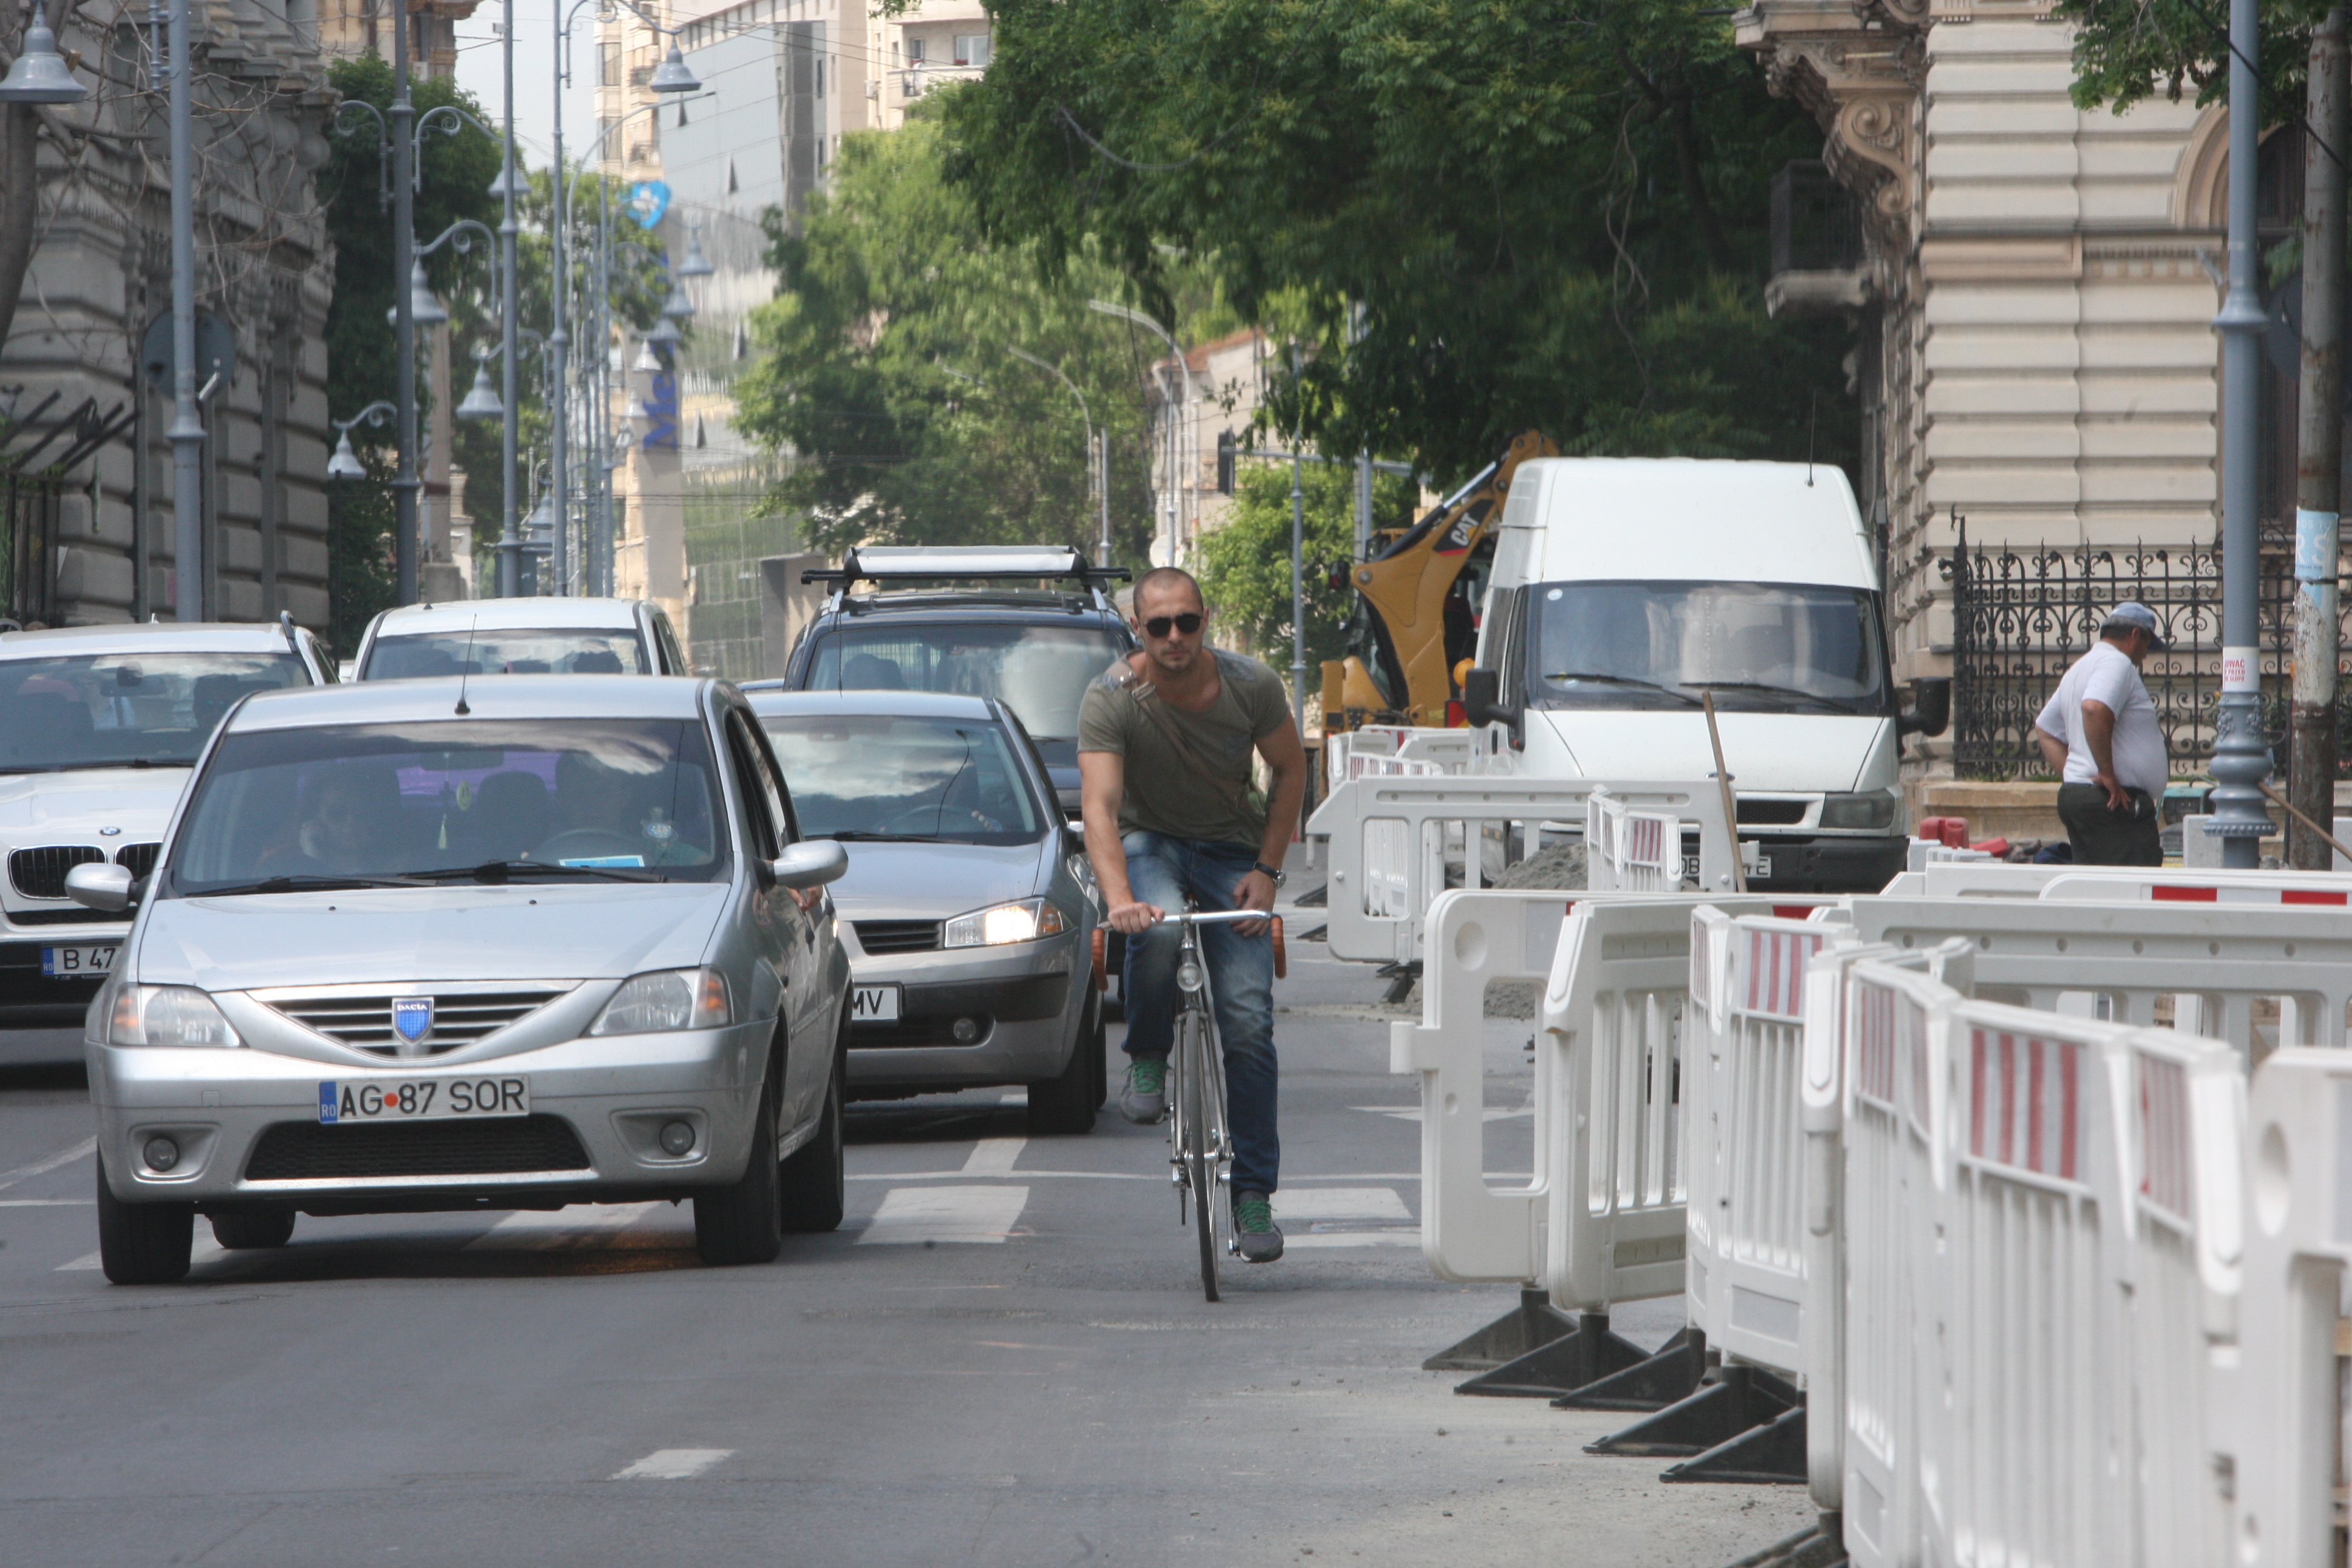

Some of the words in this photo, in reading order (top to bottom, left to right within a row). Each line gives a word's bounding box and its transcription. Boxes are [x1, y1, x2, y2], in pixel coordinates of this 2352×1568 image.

[1450, 512, 1479, 546] CAT
[44, 963, 53, 972] RO
[63, 949, 80, 970] B
[90, 947, 116, 969] 47
[340, 1083, 382, 1117] AG
[399, 1081, 437, 1114] 87
[449, 1078, 524, 1113] SOR
[321, 1103, 336, 1118] RO
